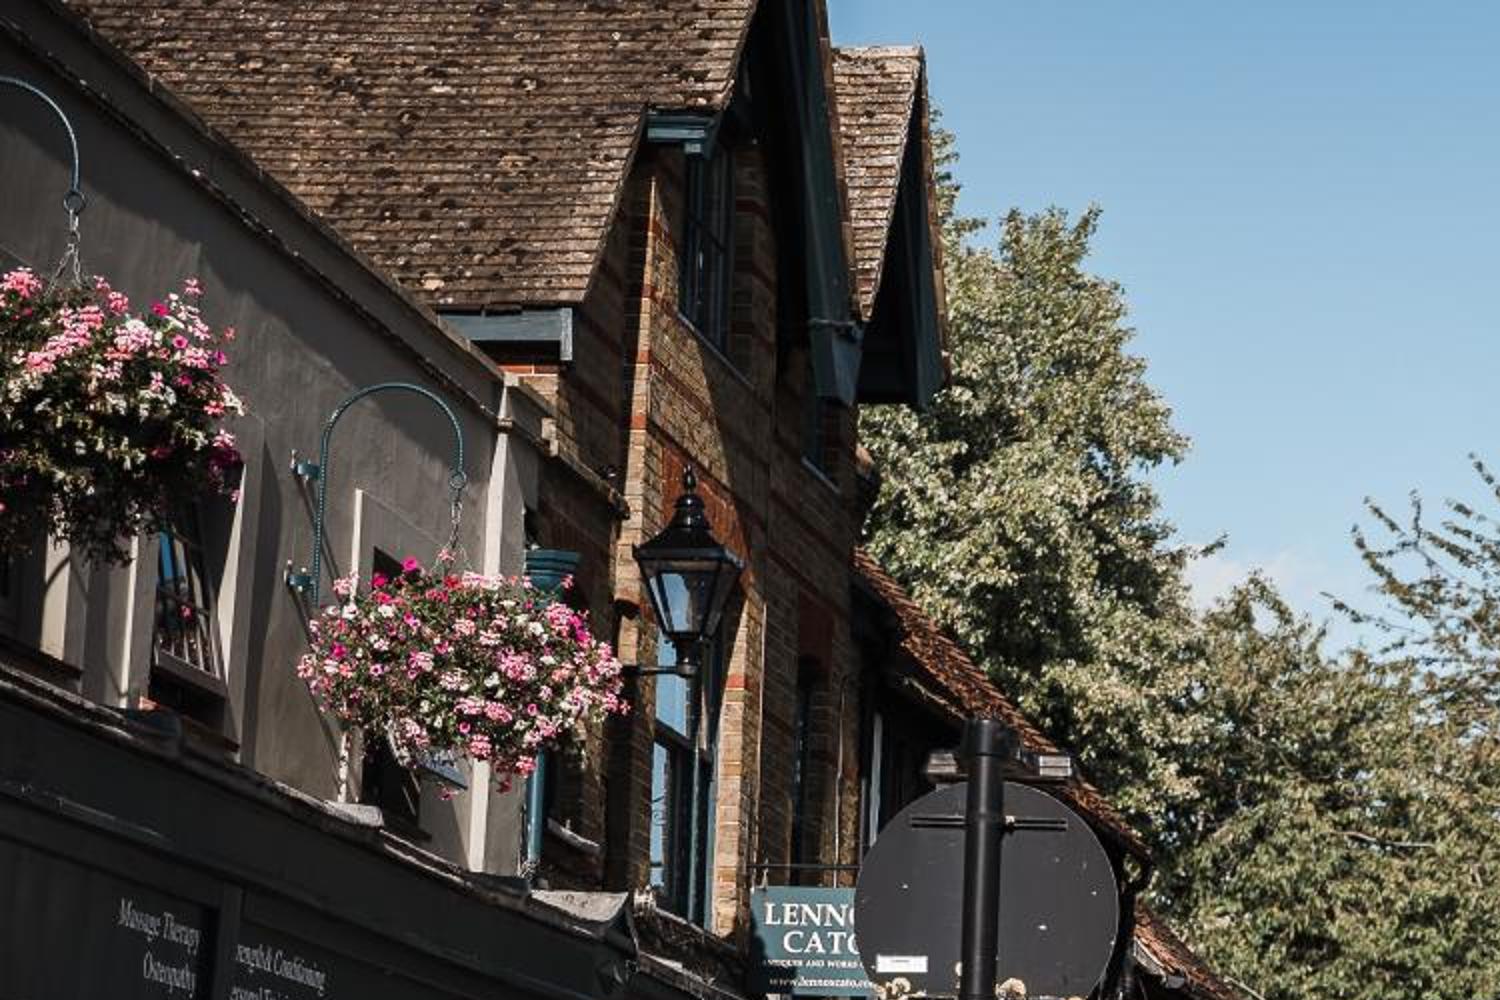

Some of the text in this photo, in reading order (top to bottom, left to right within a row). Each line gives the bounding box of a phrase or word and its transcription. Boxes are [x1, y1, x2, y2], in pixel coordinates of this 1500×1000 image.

[118, 898, 200, 955] Massage Therapy
[765, 902, 855, 926] LENN
[143, 951, 198, 999] Osteopathy
[236, 943, 266, 974] rength
[274, 950, 326, 997] Conditioning
